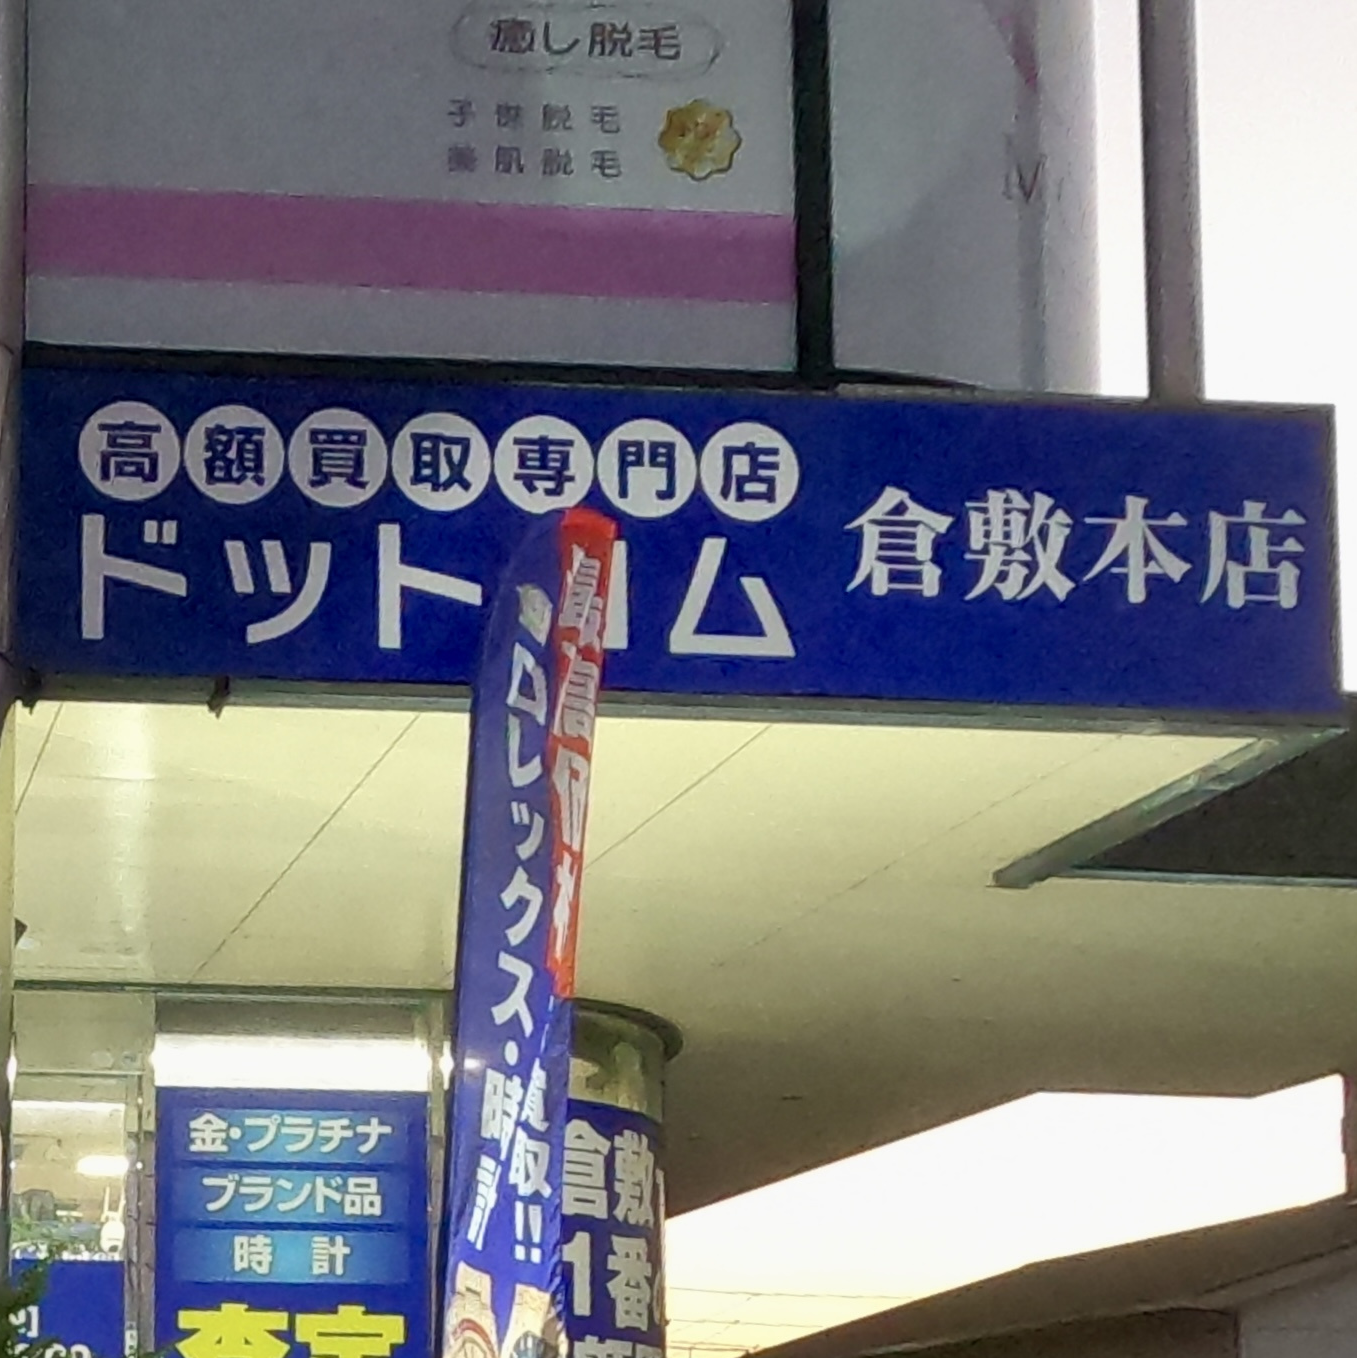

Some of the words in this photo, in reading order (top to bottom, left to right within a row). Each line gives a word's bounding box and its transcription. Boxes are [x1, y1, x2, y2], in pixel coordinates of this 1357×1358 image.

[92, 413, 786, 510] 高額買取専門店
[844, 485, 1307, 609] 倉敷本店
[189, 1112, 392, 1153] 金・プラチナ
[561, 1118, 665, 1232] 倉敷
[202, 1173, 382, 1217] ブランド品
[233, 1234, 351, 1275] 時計
[562, 1231, 661, 1332] 1番
